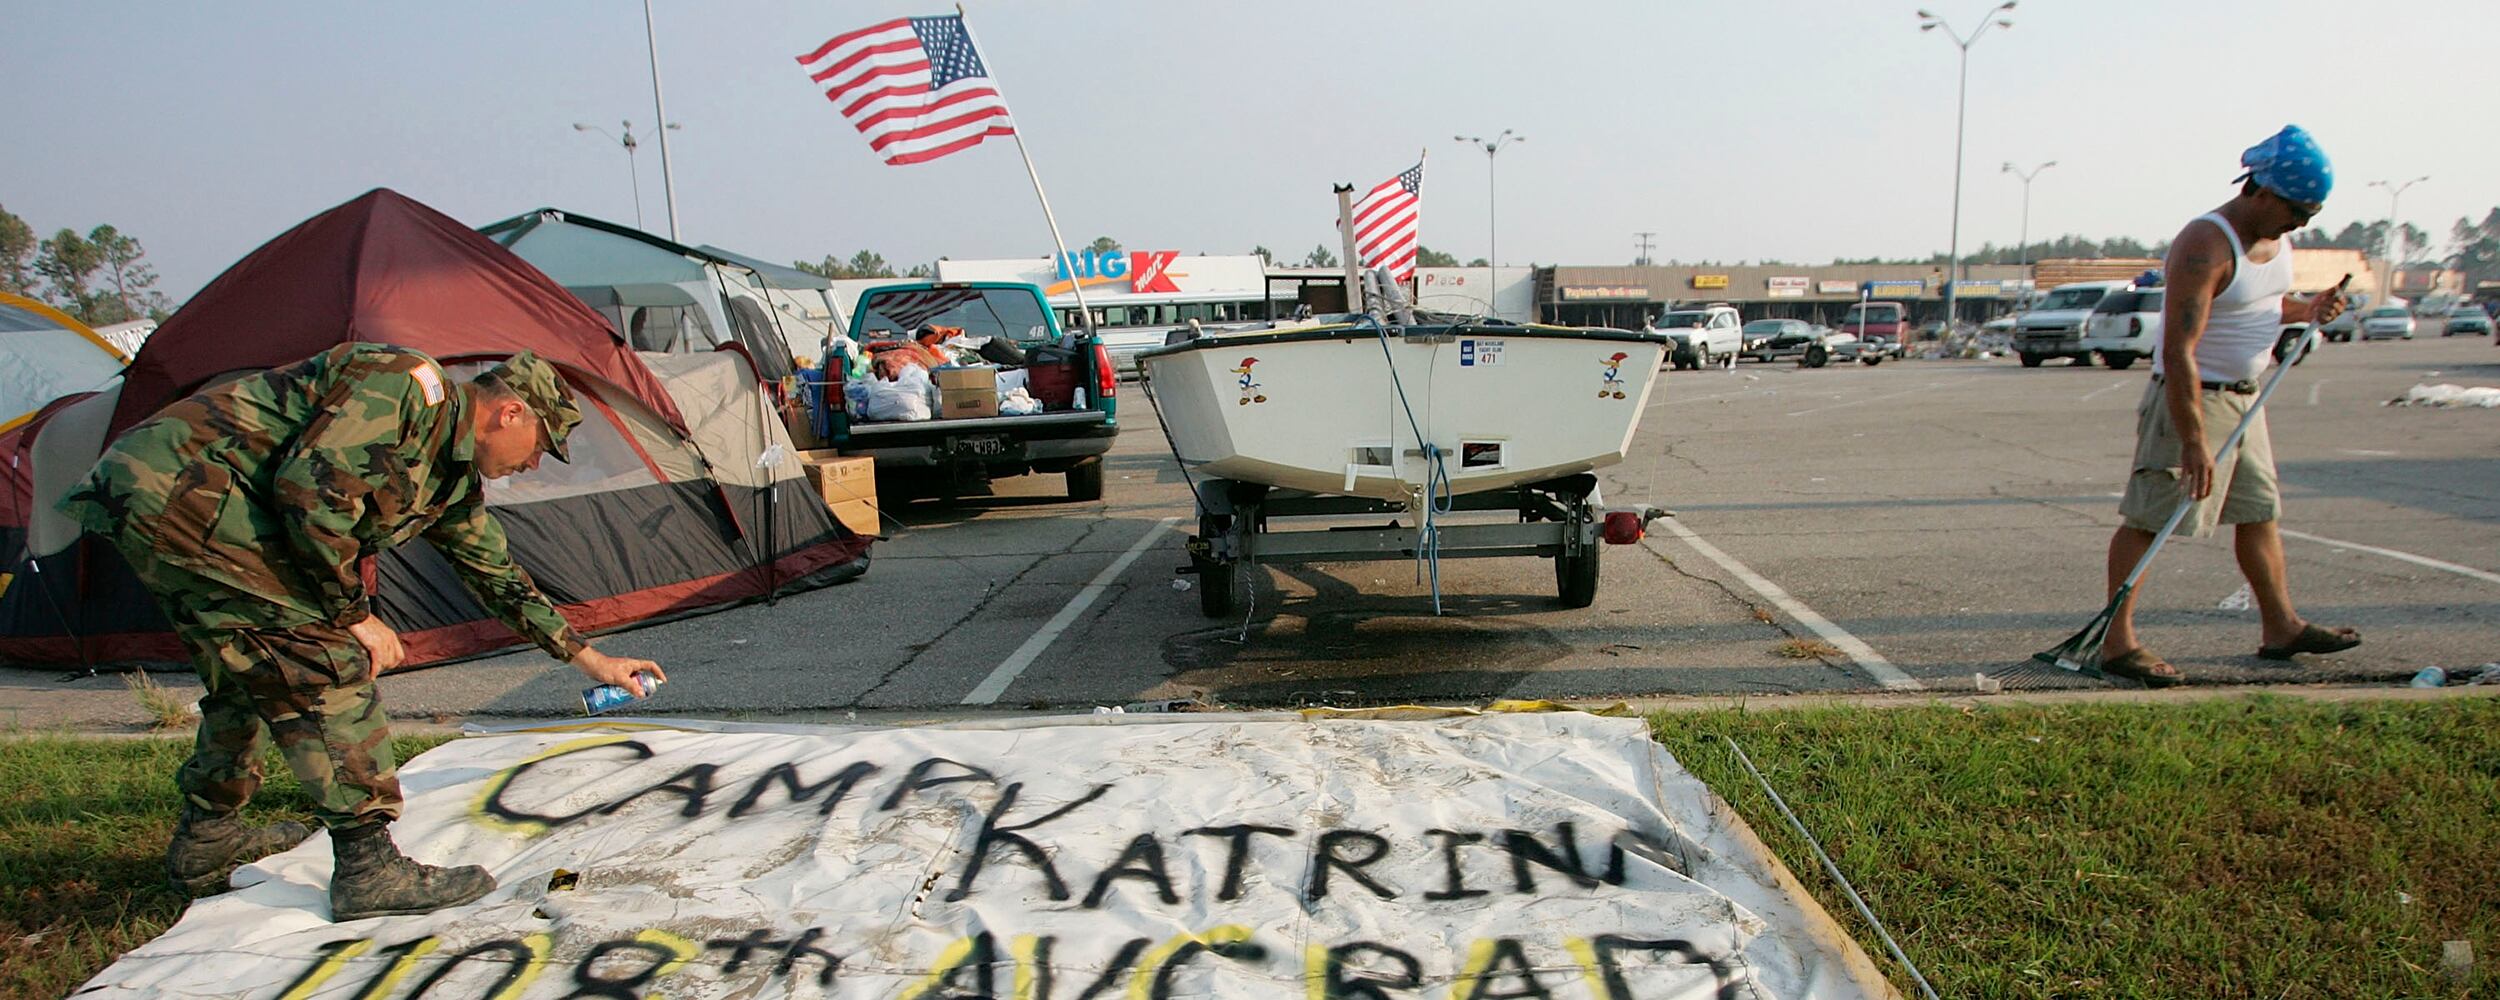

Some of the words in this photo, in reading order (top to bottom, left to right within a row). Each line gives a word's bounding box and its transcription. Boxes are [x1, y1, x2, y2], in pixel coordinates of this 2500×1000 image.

[1057, 249, 1126, 279] BIG
[1425, 274, 1465, 286] Place
[1481, 354, 1496, 364] 471
[480, 736, 994, 828] CAMP
